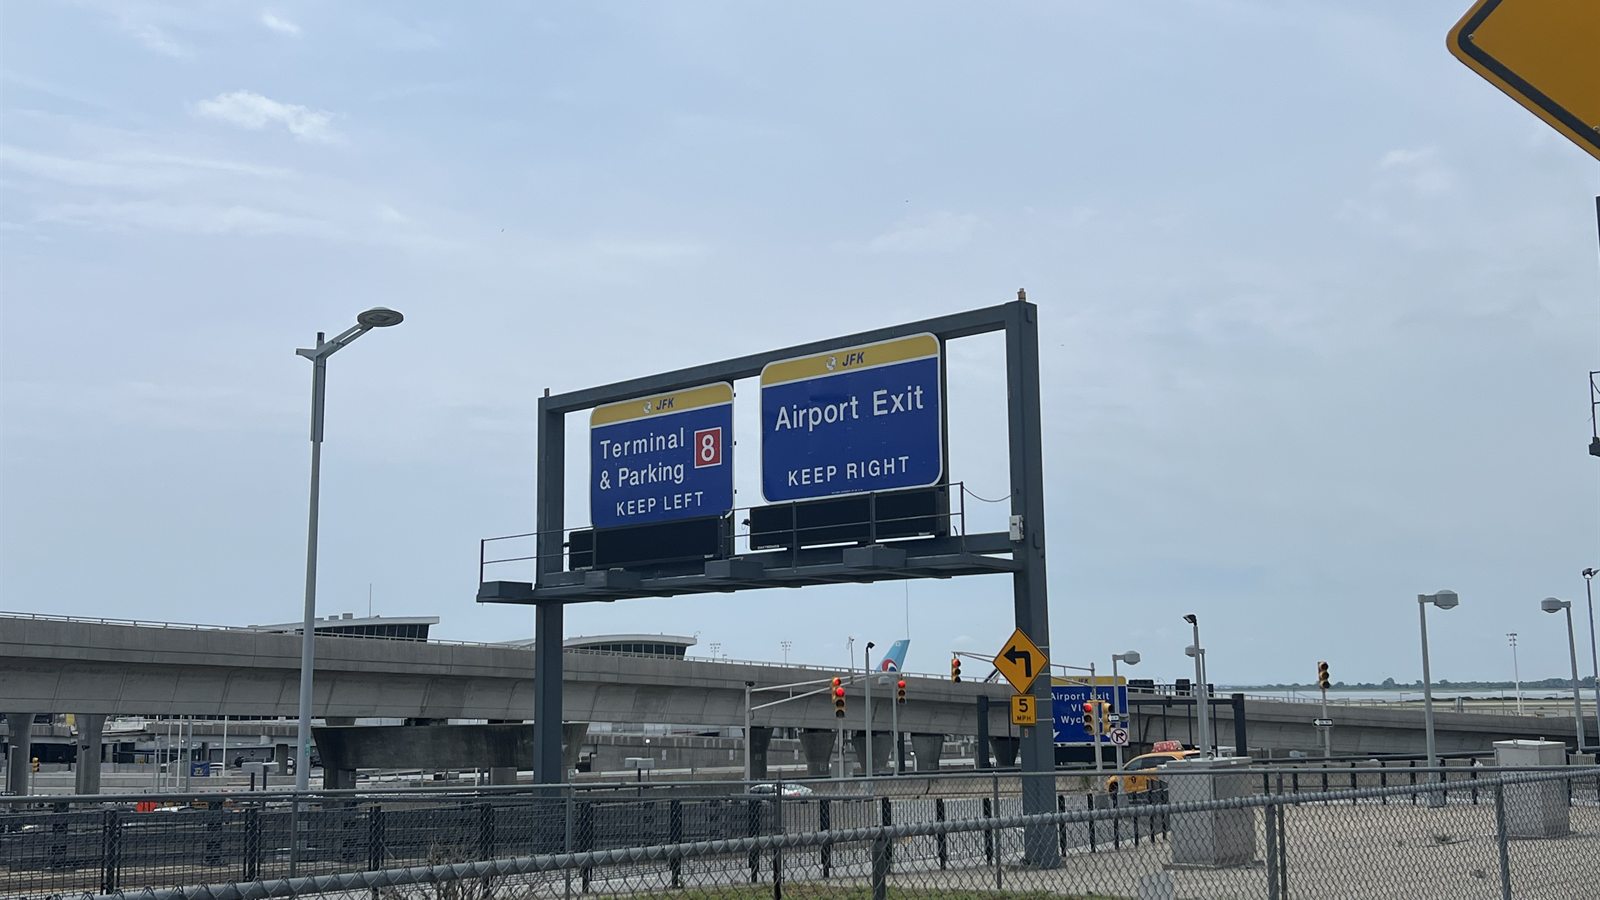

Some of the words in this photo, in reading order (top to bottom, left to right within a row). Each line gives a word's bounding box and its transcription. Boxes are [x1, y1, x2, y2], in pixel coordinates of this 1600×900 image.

[842, 352, 865, 367] JFK
[656, 398, 674, 411] JFK
[774, 396, 859, 432] Airport
[873, 385, 924, 416] Exit
[600, 427, 684, 459] Terminal
[701, 434, 715, 462] 8
[599, 470, 611, 490] &
[618, 462, 684, 488] Parking
[788, 465, 837, 487] KEEP
[846, 456, 909, 480] RIGHT
[616, 497, 657, 517] KEEP
[664, 491, 704, 511] LEFT
[1019, 698, 1029, 713] 5
[1051, 692, 1085, 702] Airport
